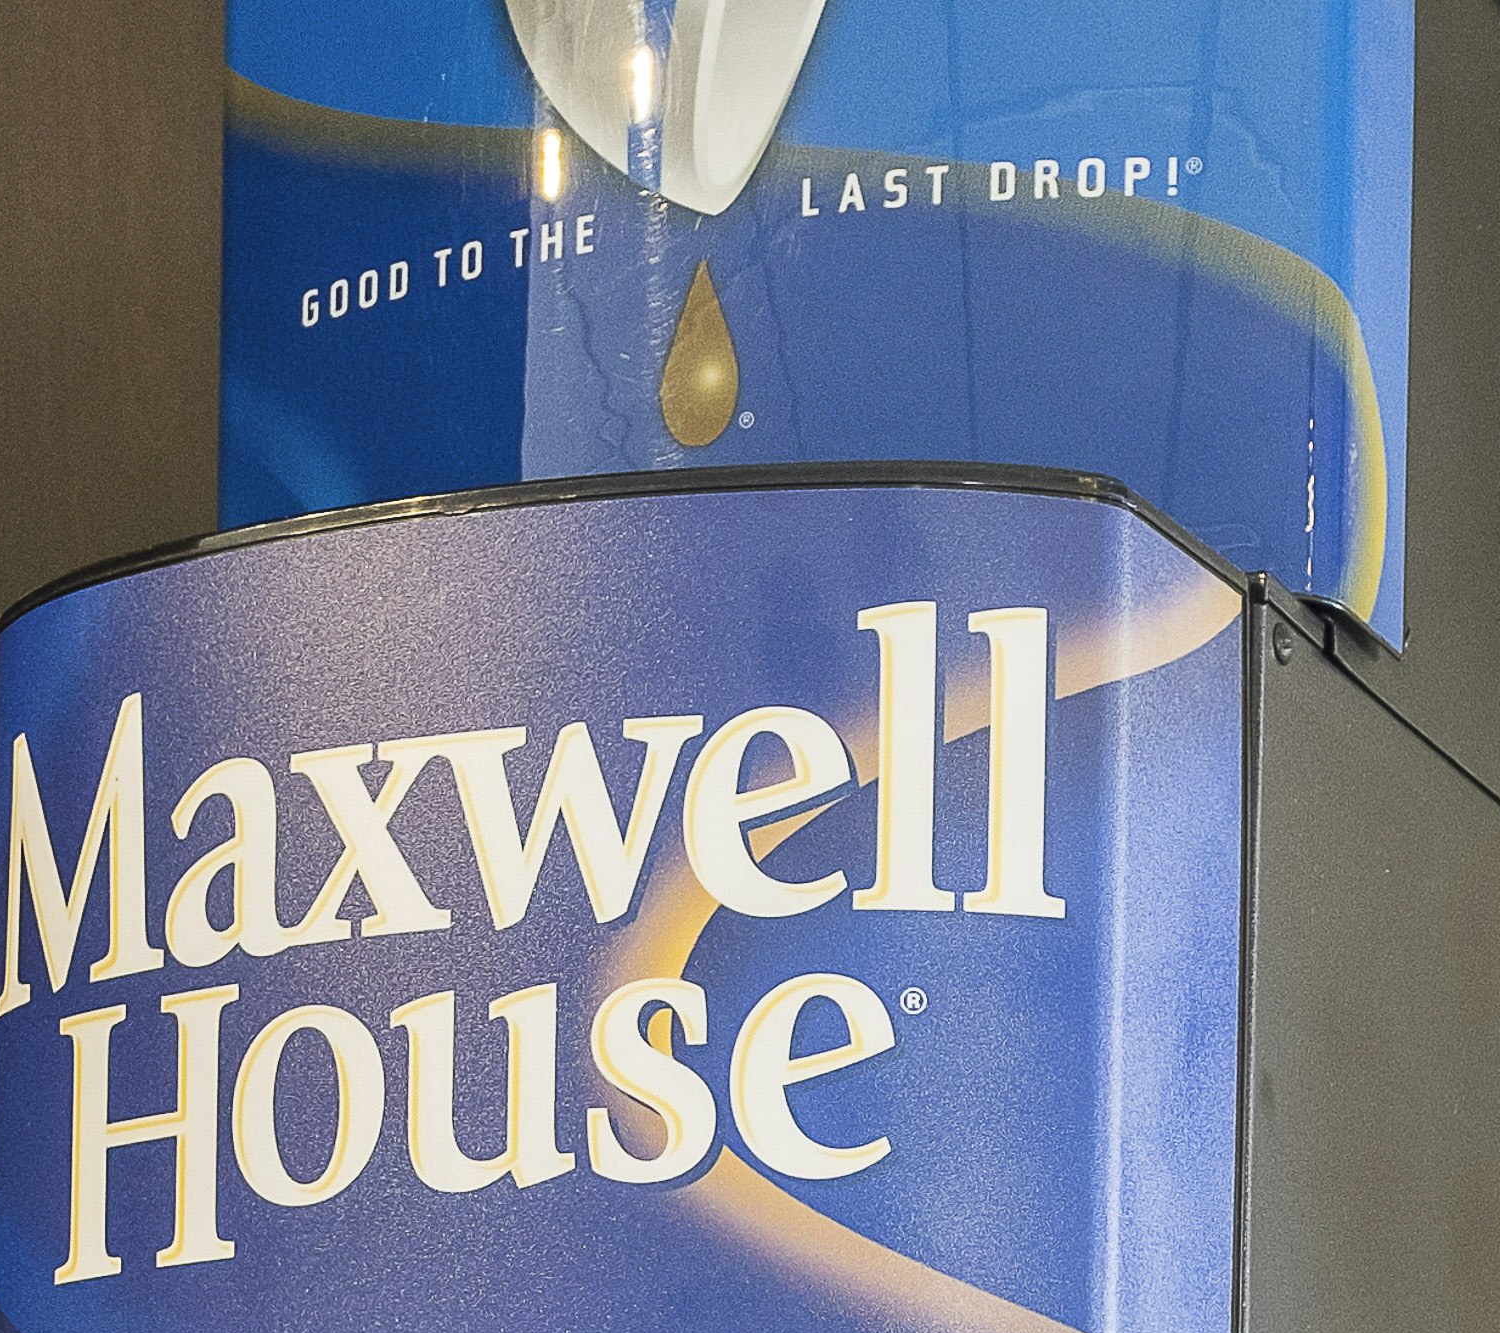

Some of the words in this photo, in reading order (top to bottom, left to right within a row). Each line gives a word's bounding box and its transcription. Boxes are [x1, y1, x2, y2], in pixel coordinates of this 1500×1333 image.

[800, 164, 949, 218] LAST
[989, 155, 1180, 203] DROP!
[300, 261, 408, 327] GOOD
[434, 240, 483, 290] TO
[509, 215, 596, 270] THE
[52, 972, 899, 1287] House
